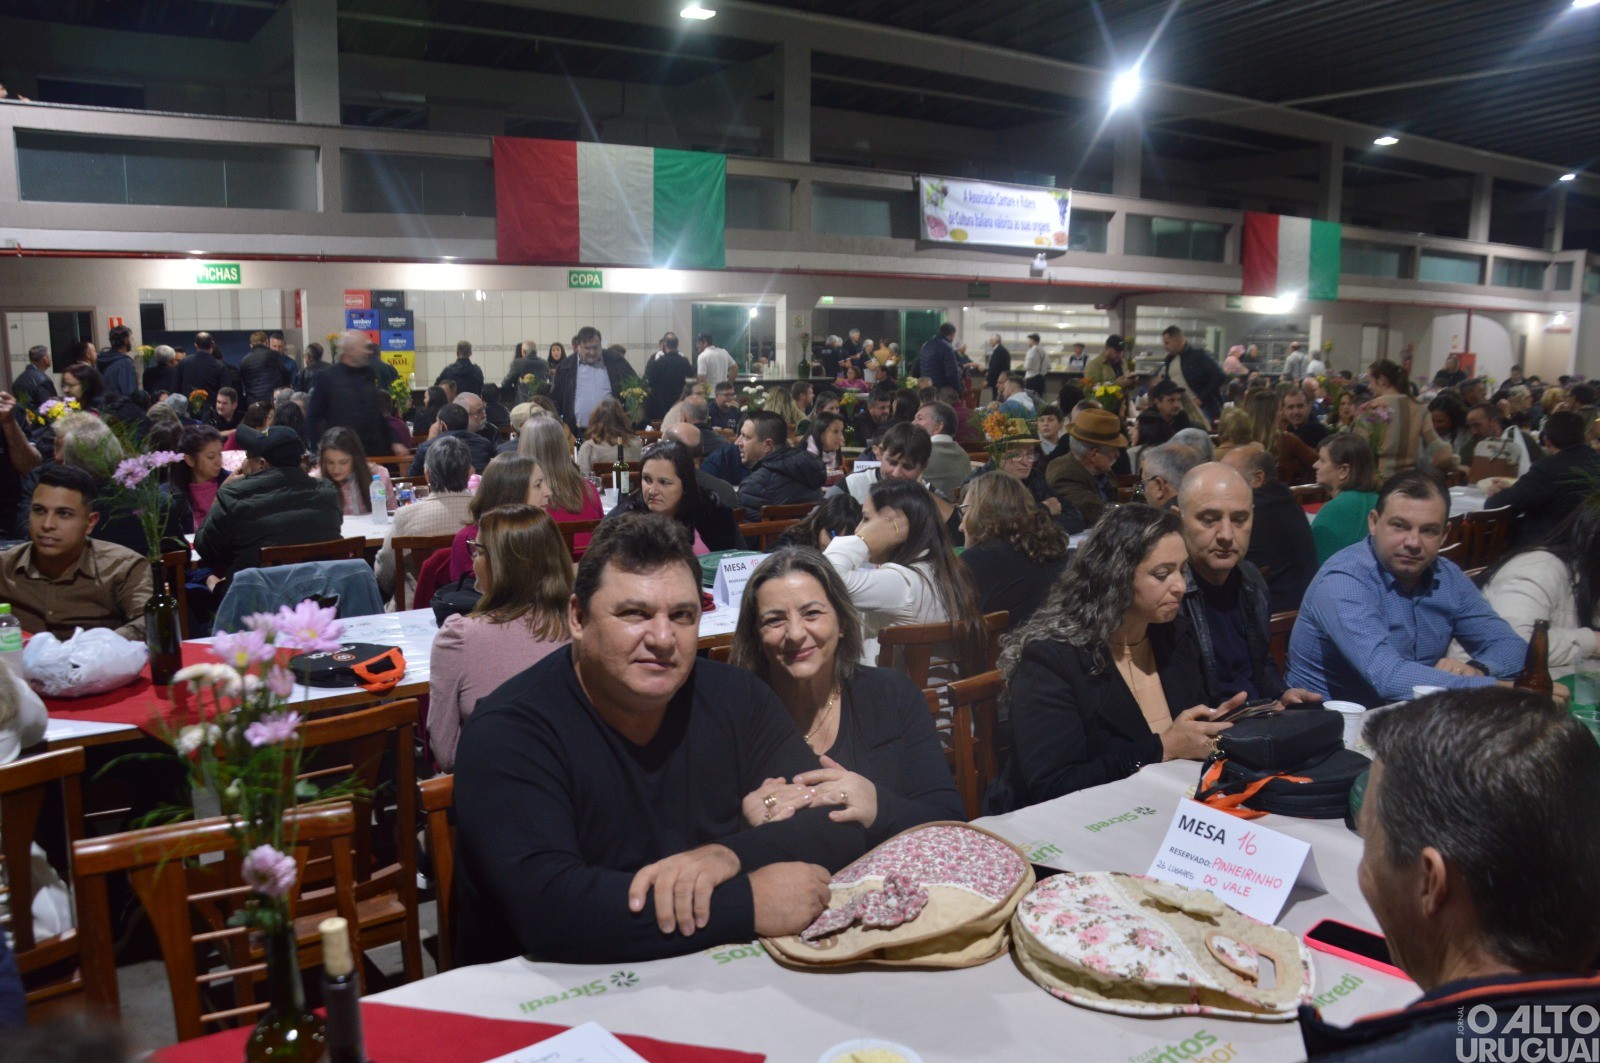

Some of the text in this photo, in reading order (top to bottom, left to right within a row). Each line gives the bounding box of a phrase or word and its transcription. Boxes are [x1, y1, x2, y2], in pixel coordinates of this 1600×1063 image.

[570, 273, 601, 286] COPA
[724, 562, 747, 572] MESA
[1085, 812, 1139, 833] Sicredi
[1178, 814, 1258, 856] MESA 16
[1156, 860, 1195, 880] 26 LUGARES
[1168, 846, 1283, 889] RESERVADO: PINHEIRINHO
[1203, 874, 1252, 897] DO VALE
[519, 979, 608, 1014] Sicredi
[1311, 973, 1364, 1008] icredi
